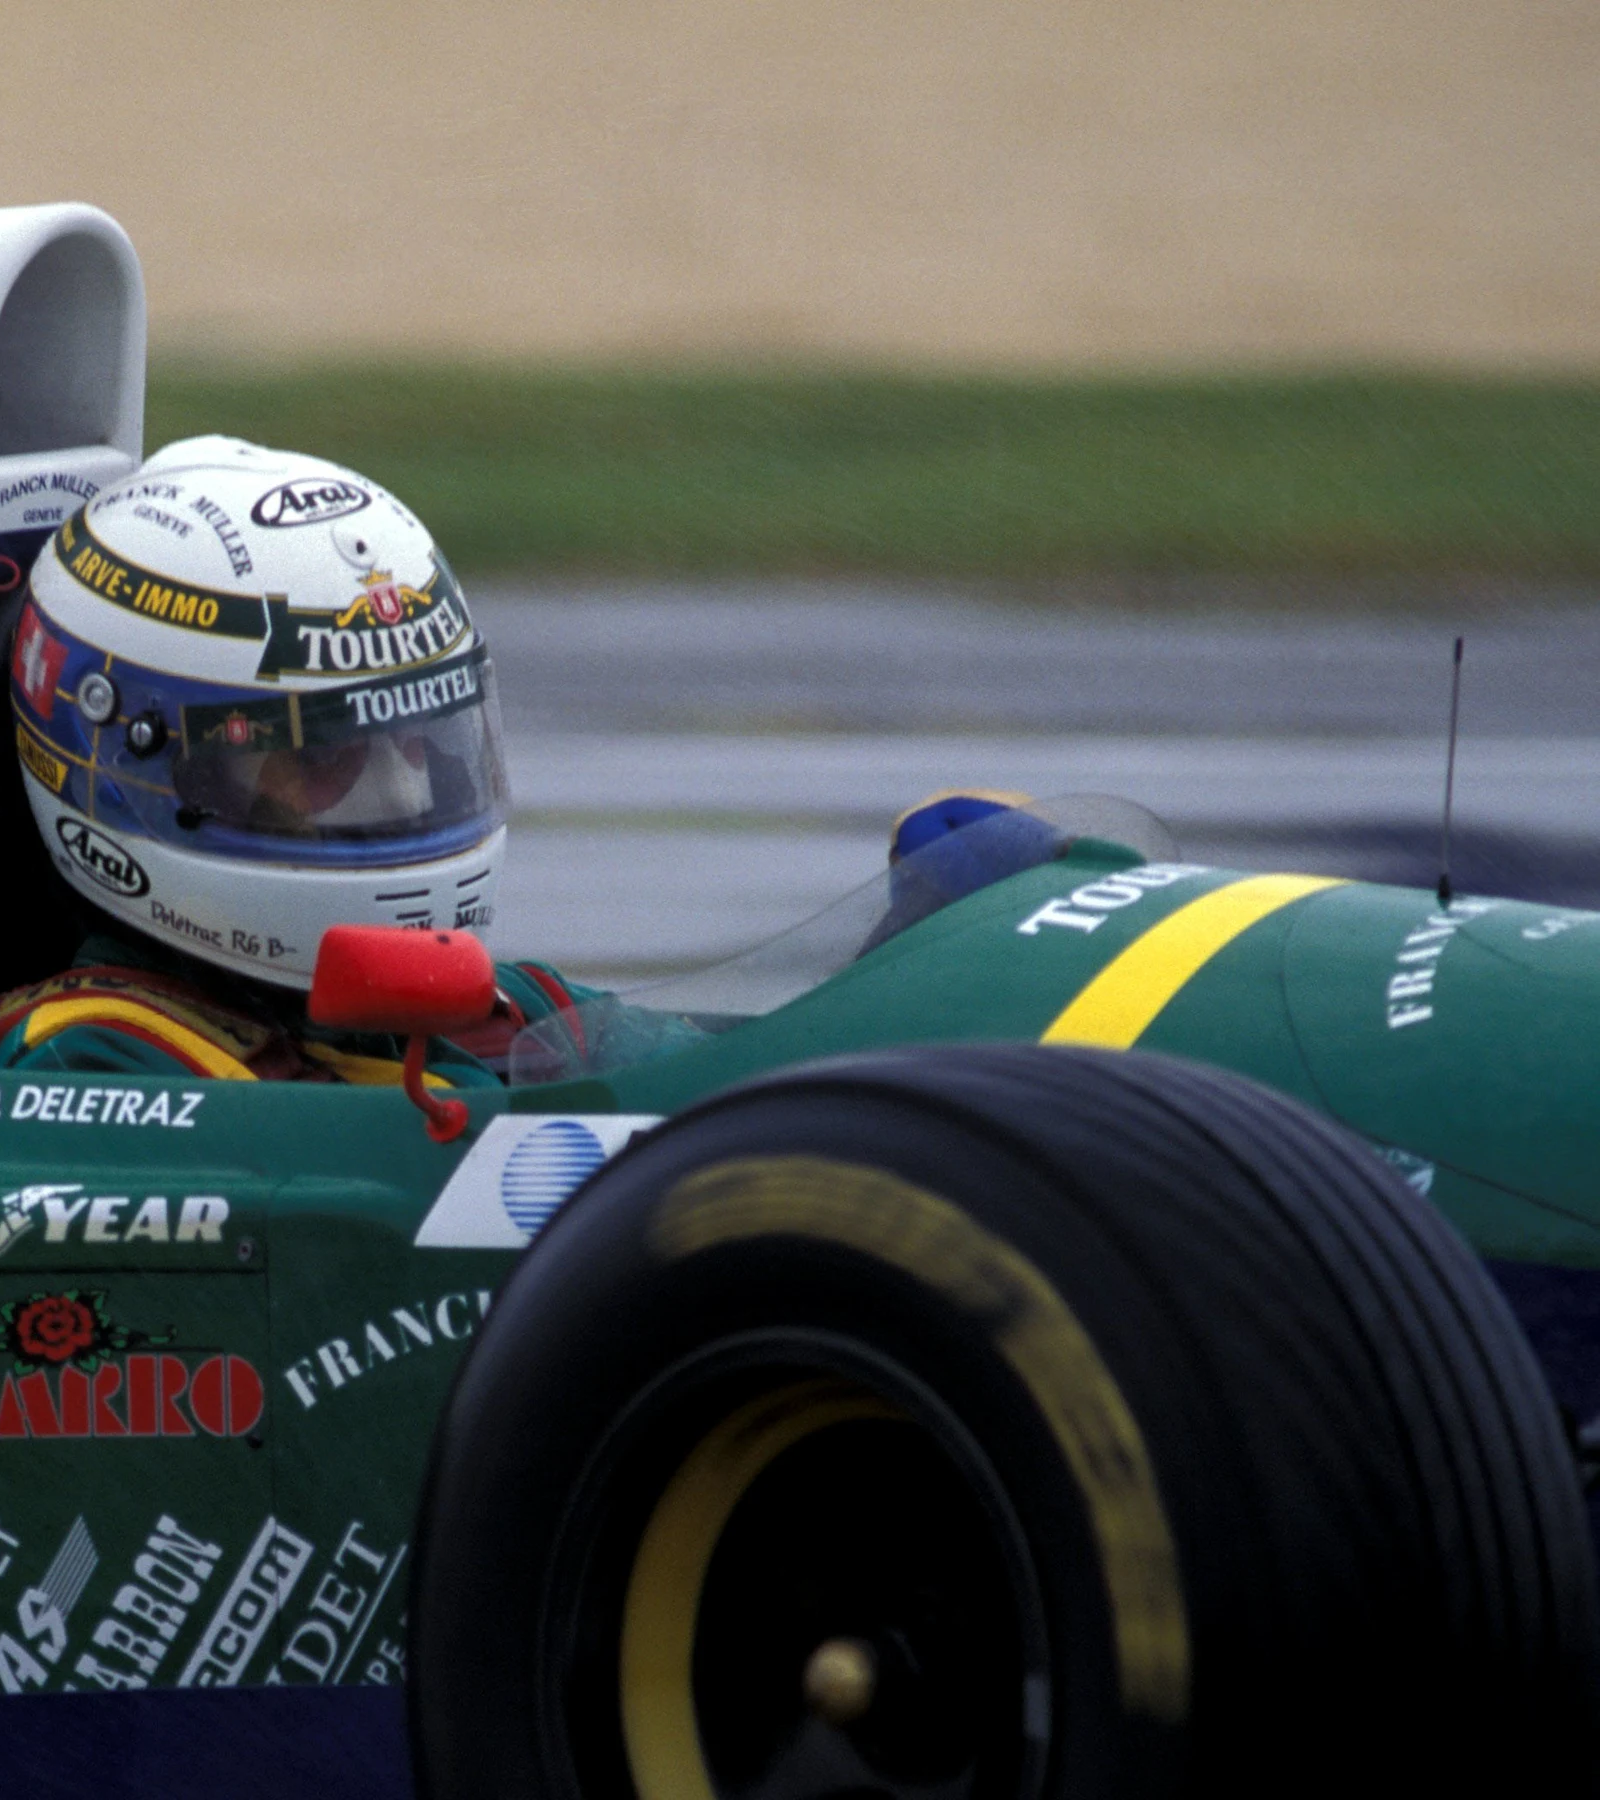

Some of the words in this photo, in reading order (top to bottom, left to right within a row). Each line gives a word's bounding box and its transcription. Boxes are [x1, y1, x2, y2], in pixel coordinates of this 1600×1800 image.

[22, 507, 64, 524] GENEVE
[190, 494, 253, 578] MULLER
[298, 597, 464, 671] TOURTEL
[346, 666, 478, 726] TOURTEL
[68, 826, 138, 887] Arai
[10, 1085, 205, 1129] DELETRAZ
[63, 1513, 223, 1692] ARRON
[265, 1521, 388, 1686] DET
